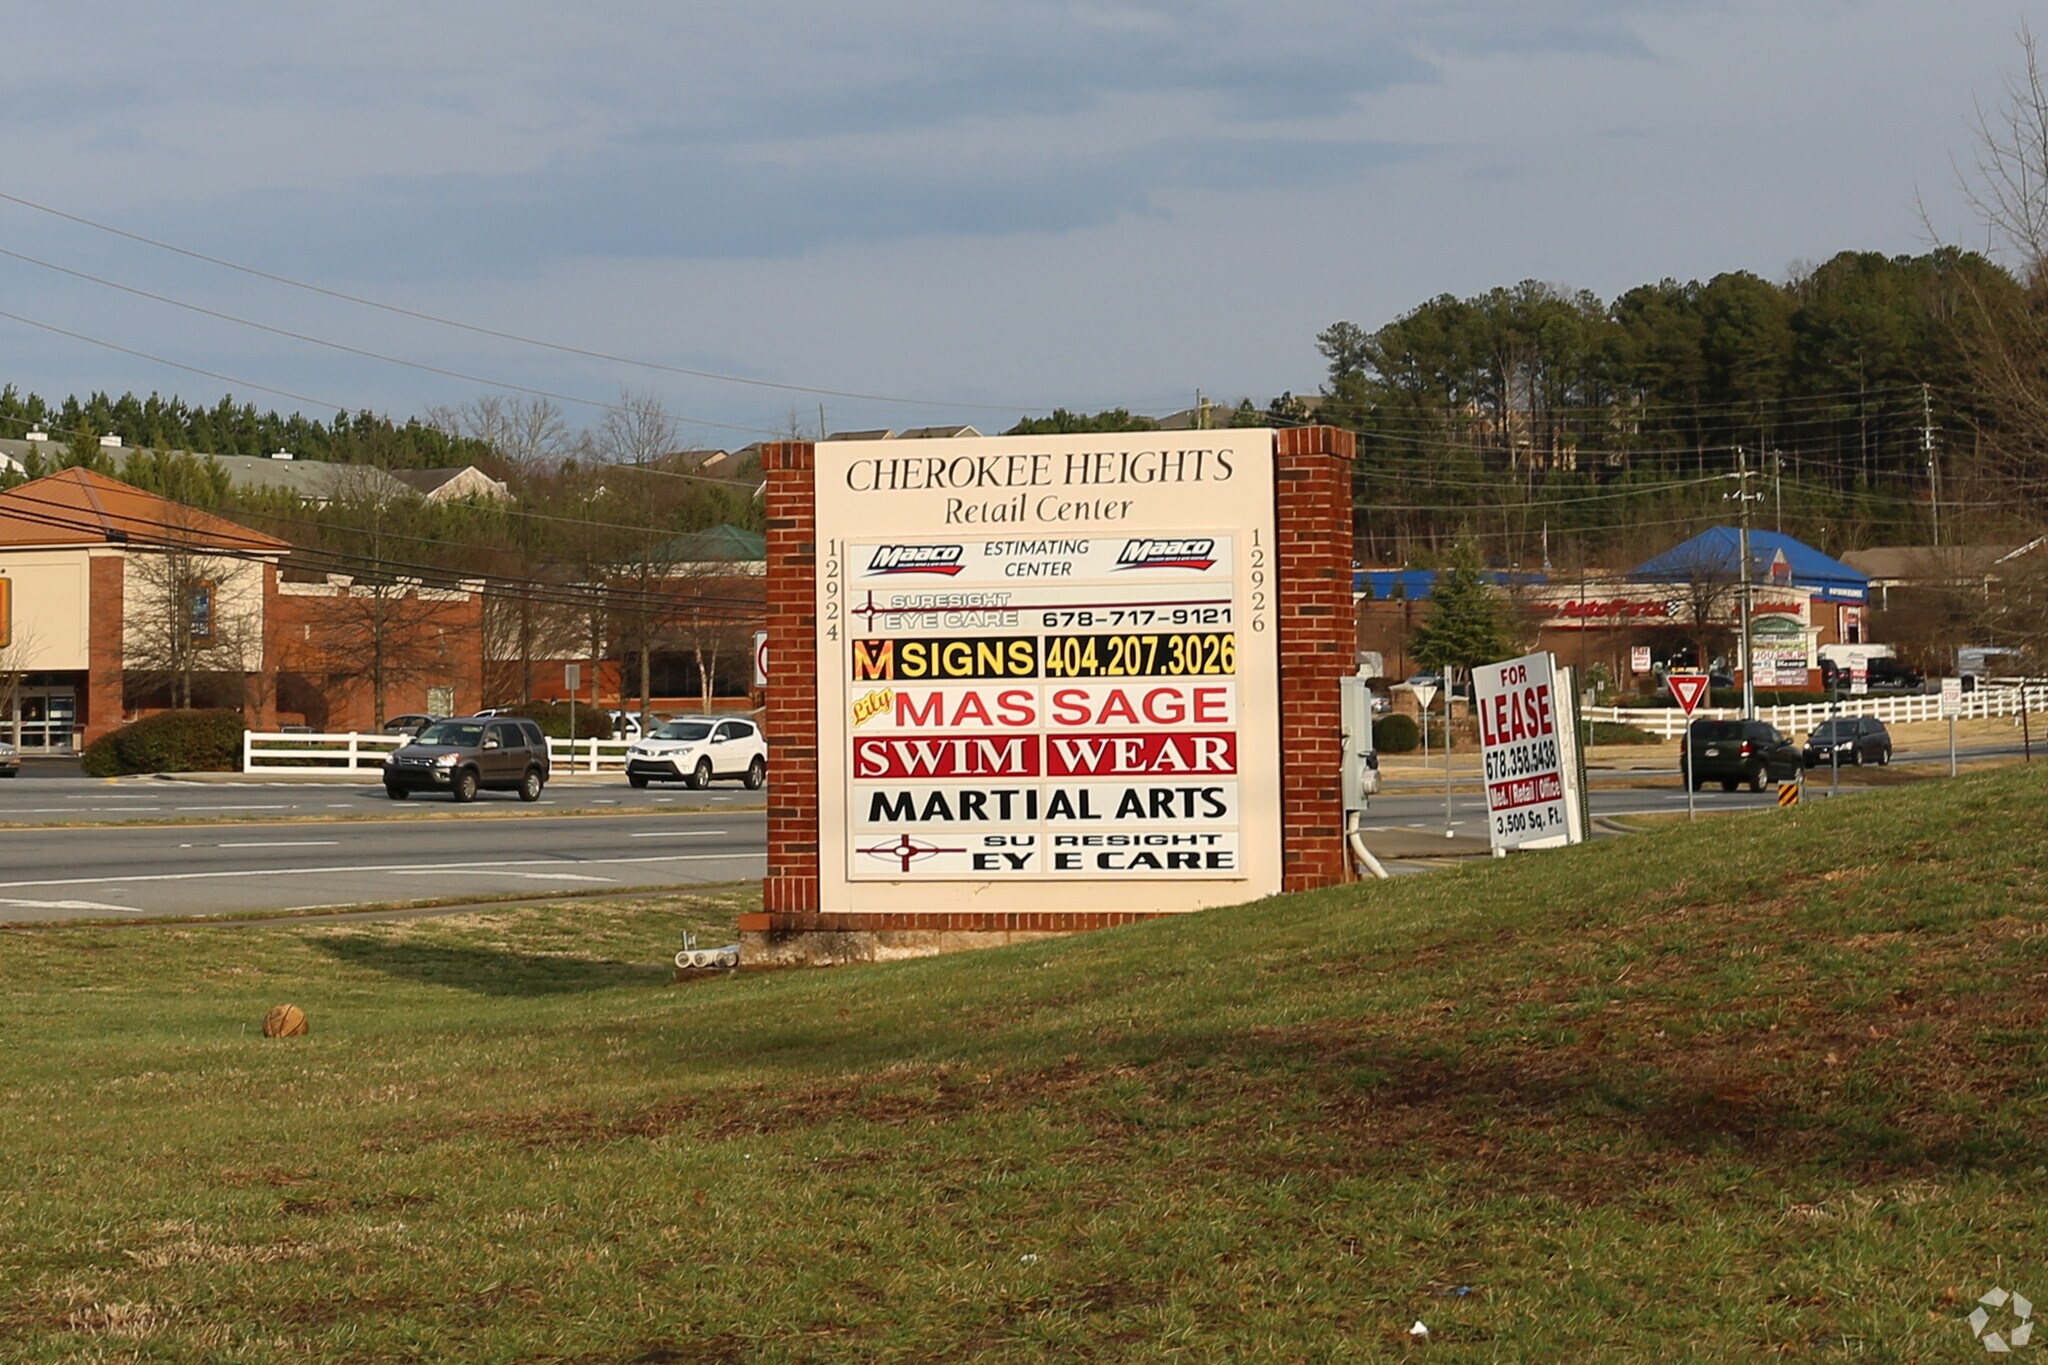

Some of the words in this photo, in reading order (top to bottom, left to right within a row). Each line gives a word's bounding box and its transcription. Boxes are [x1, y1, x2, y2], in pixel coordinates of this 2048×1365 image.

[846, 455, 1052, 492] CHEROKEE
[1062, 449, 1234, 486] HEIGHTS
[945, 493, 1027, 524] Retail
[1036, 495, 1134, 522] Center
[868, 545, 963, 570] Maaco
[984, 539, 1090, 556] ESTIMATING
[1116, 539, 1215, 565] Maaco
[1004, 561, 1072, 577] CENTER
[891, 593, 1012, 608] SURESIGHT
[884, 612, 939, 630] EYE
[943, 610, 1019, 628] CARE
[1042, 608, 1232, 627] 678-717-9121
[900, 640, 1035, 677] SIGNS
[1046, 633, 1235, 677] 404.207.3026
[1500, 664, 1527, 687] FOR
[853, 690, 893, 726] Lily
[1481, 684, 1553, 747] LEASE
[859, 738, 1028, 776] SWIM
[1051, 736, 1235, 773] WEAR
[1486, 739, 1557, 781] 678.358.5438
[868, 789, 1101, 822] MARTIAL
[1114, 787, 1227, 819] ARTS
[1512, 781, 1536, 804] Retail
[1496, 812, 1526, 837] 3,500
[1528, 809, 1547, 831] Sq.
[1548, 806, 1563, 826] Ft.
[1096, 851, 1234, 870] CARE
